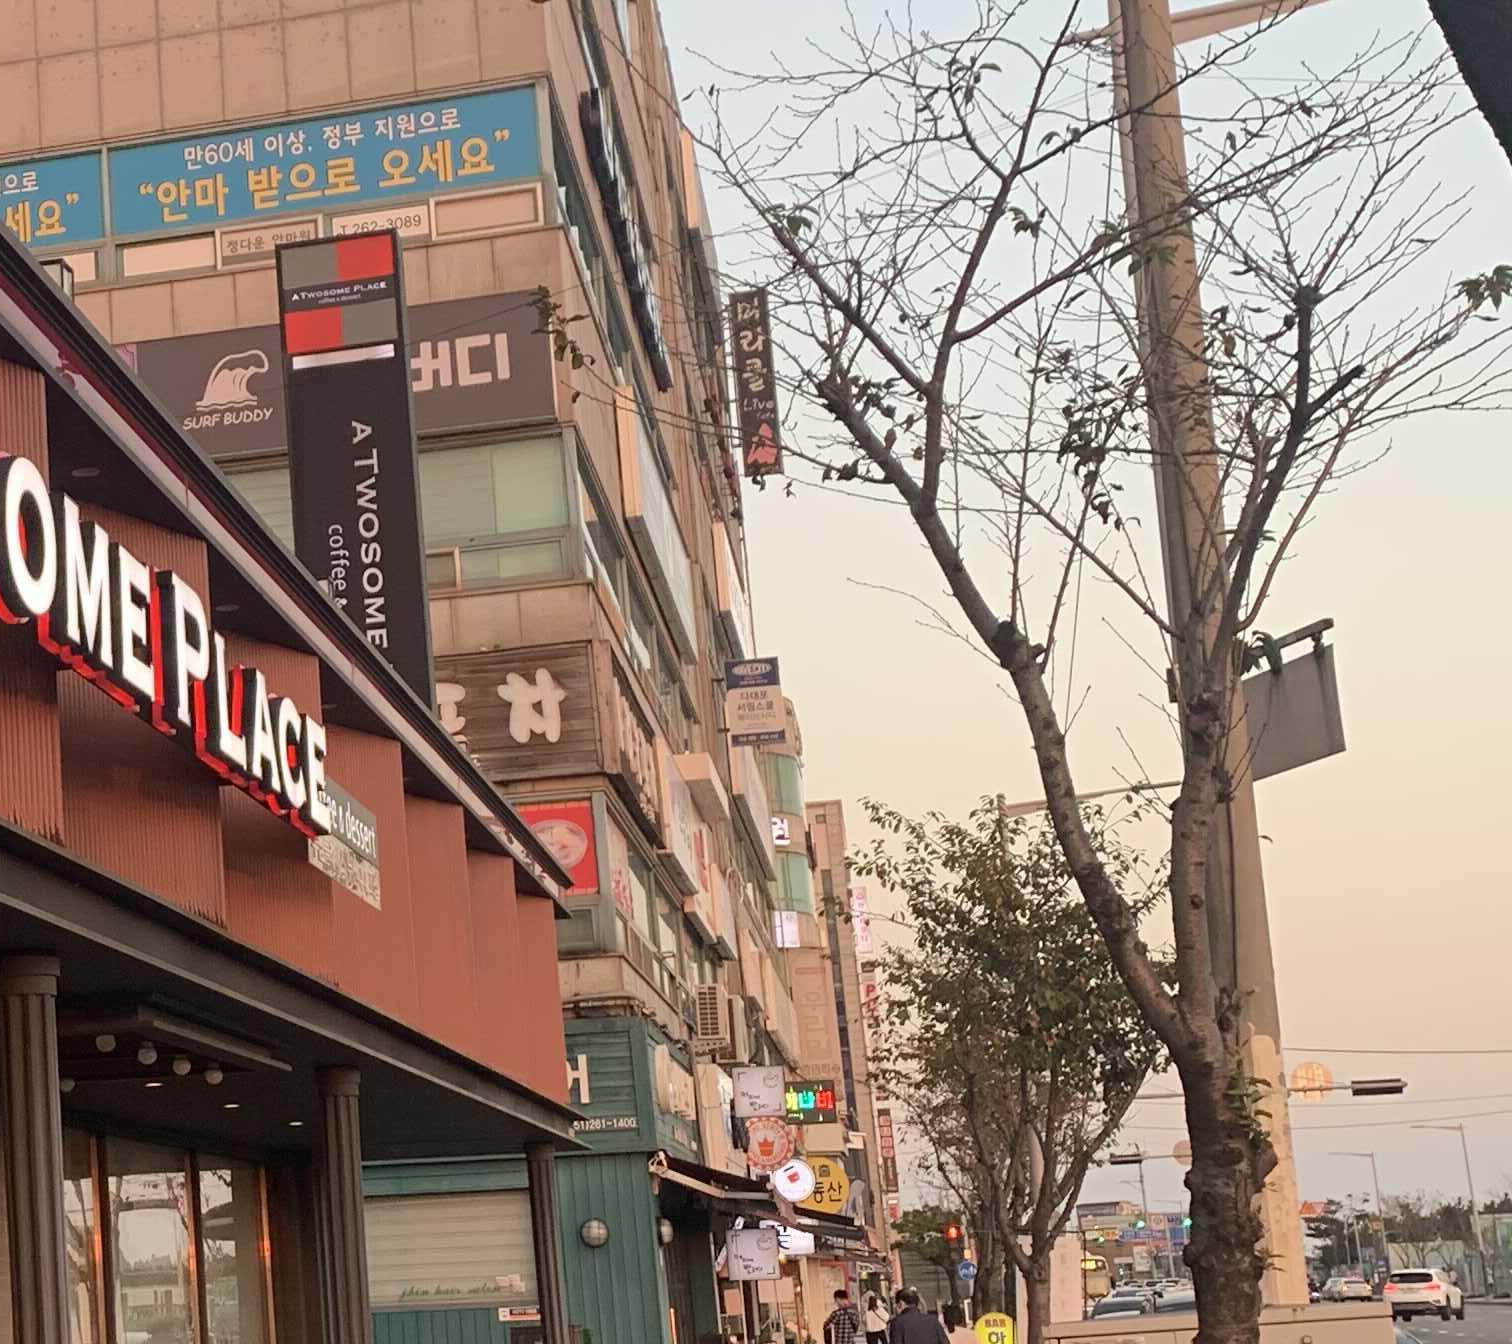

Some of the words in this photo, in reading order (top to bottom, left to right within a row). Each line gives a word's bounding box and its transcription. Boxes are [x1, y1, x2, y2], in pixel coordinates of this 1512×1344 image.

[183, 137, 255, 170] 만60세
[322, 122, 364, 149] 정부
[375, 108, 461, 141] 지원으로
[248, 157, 361, 210] 받으로
[5, 192, 79, 243] 세요”
[226, 235, 265, 254] 정다운
[353, 281, 388, 293] PLACE
[183, 412, 222, 430] SURF
[223, 408, 274, 425] BUDDY
[351, 420, 373, 445] A
[328, 523, 348, 589] coffee
[354, 448, 389, 649] TWOSOME
[158, 570, 331, 836] PLACE
[345, 801, 377, 859] dessert
[813, 1181, 843, 1204] 동산
[984, 1318, 1007, 1328] BAR
